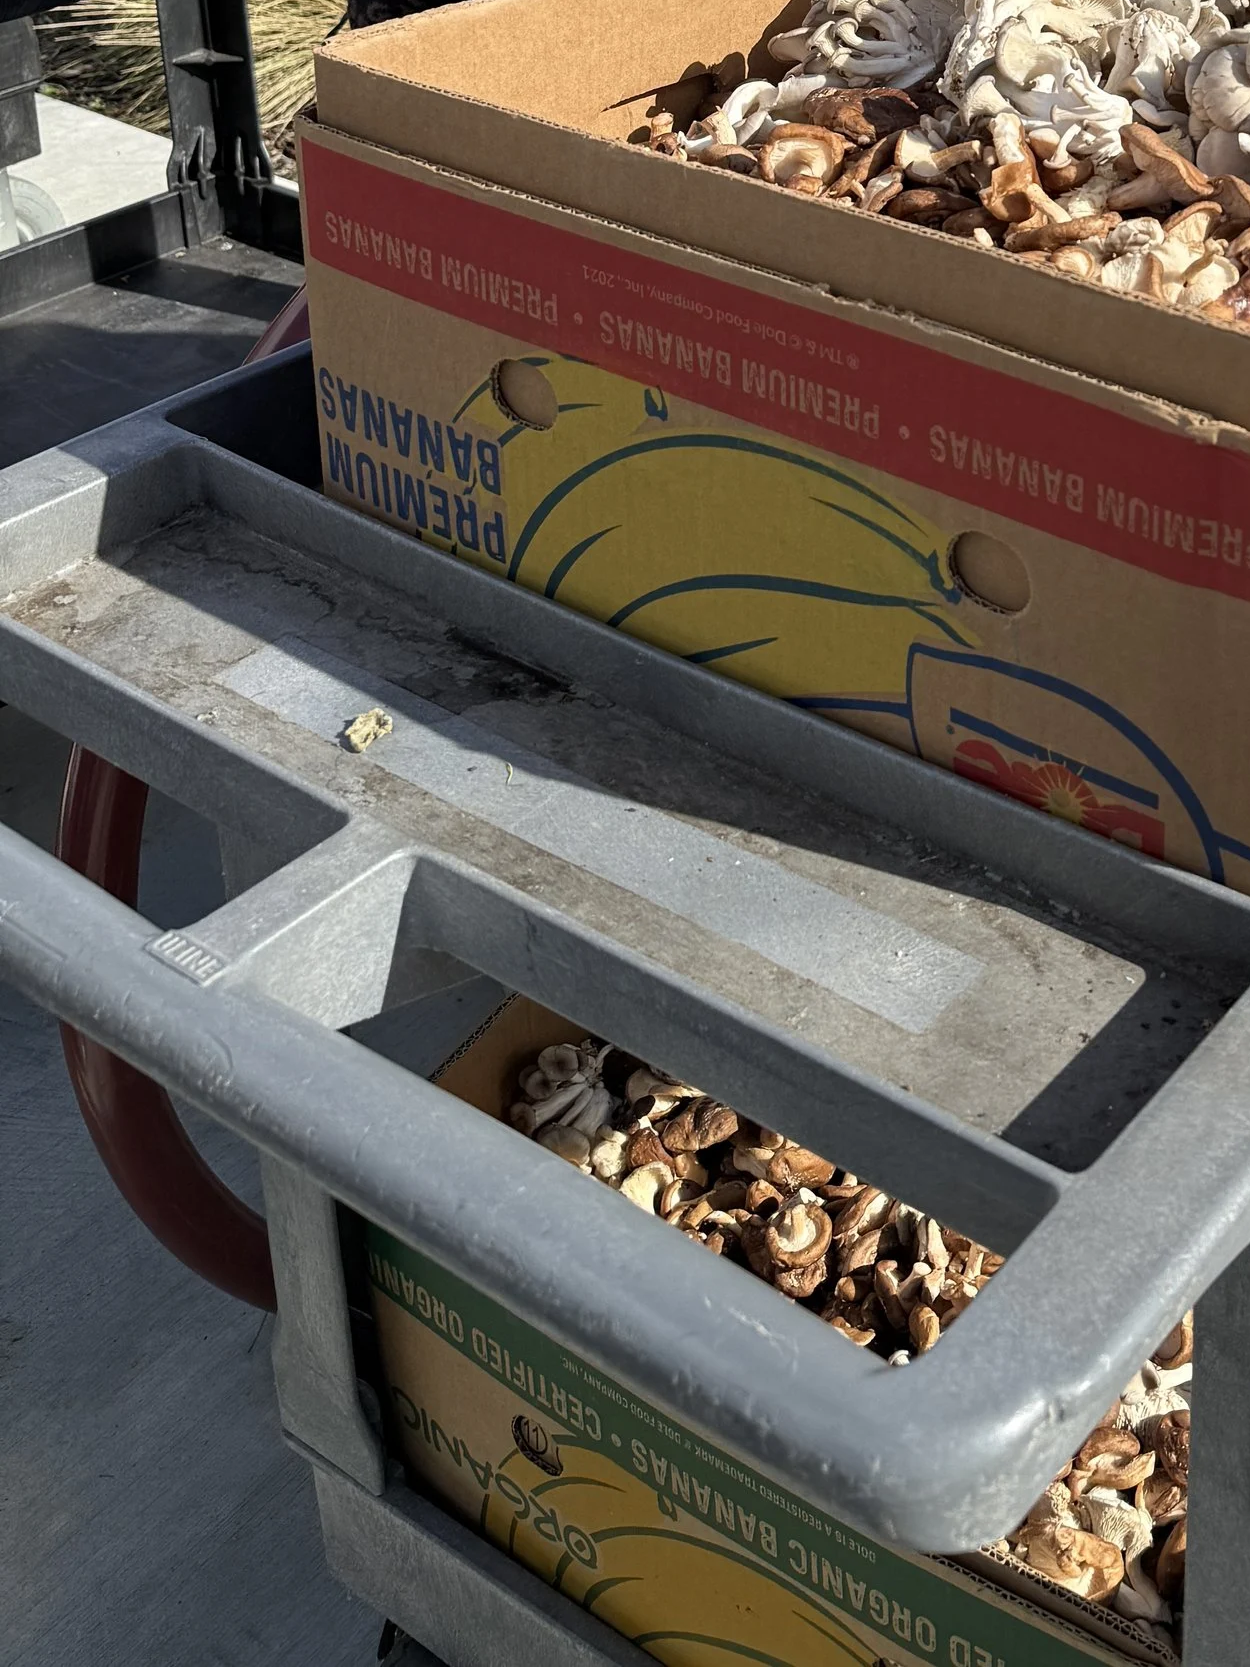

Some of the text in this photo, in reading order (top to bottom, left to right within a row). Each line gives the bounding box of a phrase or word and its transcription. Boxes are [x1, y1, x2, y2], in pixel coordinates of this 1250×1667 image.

[324, 210, 433, 280] BANANAS
[581, 264, 615, 288] 2021
[440, 256, 559, 327] PREMIUM
[650, 285, 713, 321] Company,
[715, 310, 751, 333] Food
[600, 310, 732, 385] BANANAS
[753, 319, 787, 347] Dole
[318, 366, 501, 497] BANANAS
[742, 358, 882, 440] PREMIUM
[327, 430, 508, 566] PREMIUM
[930, 424, 1084, 514] BANANAS
[152, 931, 220, 979] ULINE
[471, 1326, 603, 1441] CERTIFIED
[391, 1386, 599, 1570] ORGANIC
[631, 1438, 779, 1558] BANANAS
[694, 1444, 757, 1492] TRADEMARK
[759, 1488, 823, 1532] REGISTERED
[849, 1540, 877, 1564] DOLE
[787, 1538, 937, 1653] ORGANIC
